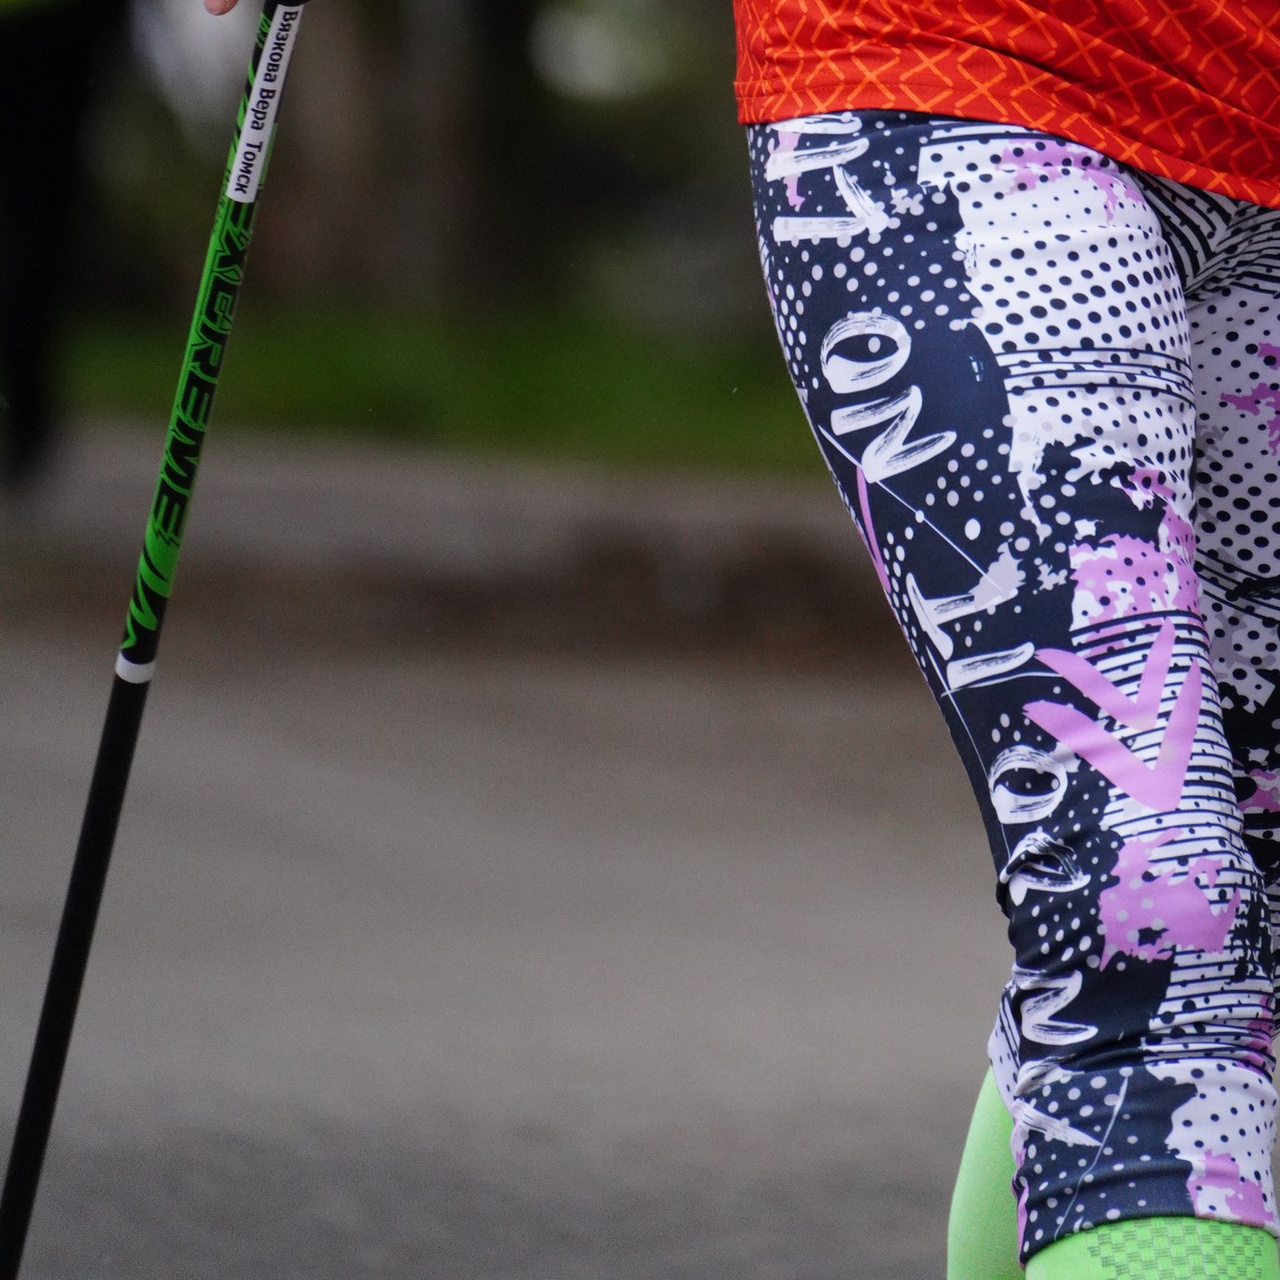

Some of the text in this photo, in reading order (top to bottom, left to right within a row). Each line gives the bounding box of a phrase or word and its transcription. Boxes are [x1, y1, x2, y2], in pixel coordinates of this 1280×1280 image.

[234, 10, 299, 195] Вязкова Вера Томск
